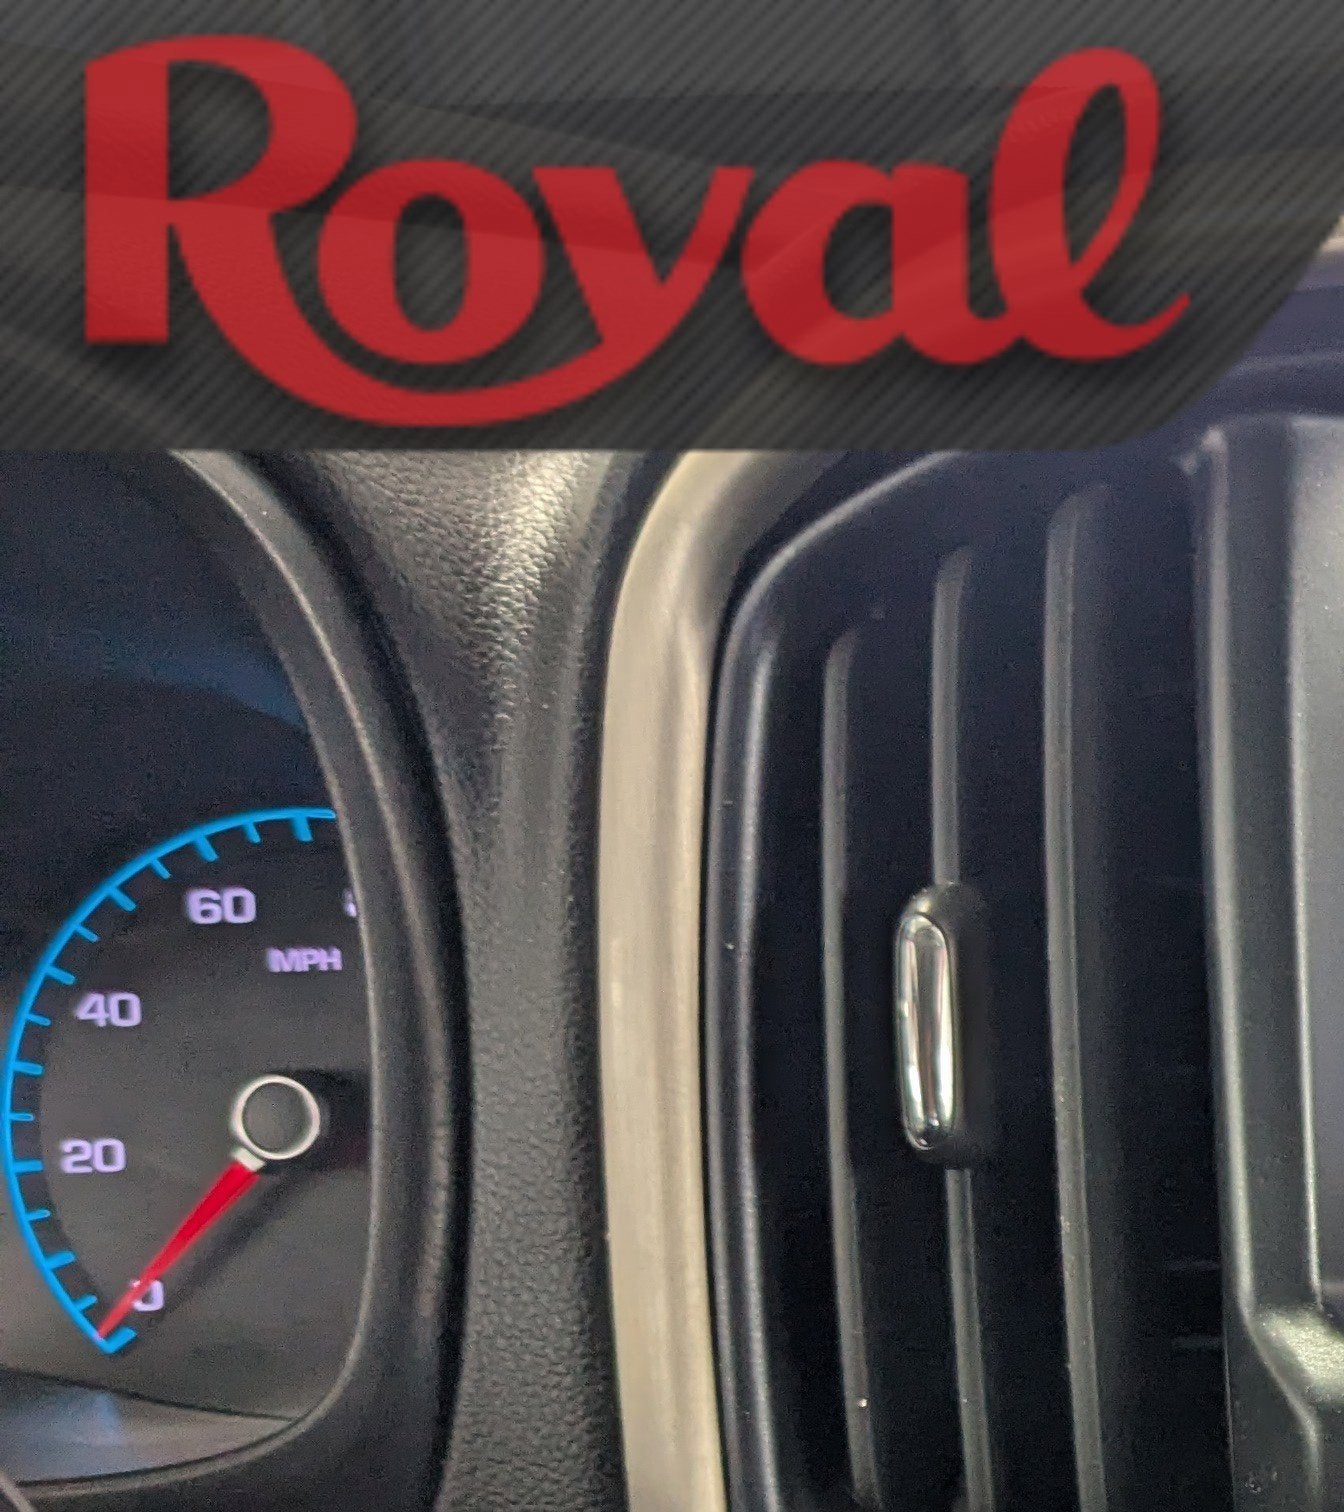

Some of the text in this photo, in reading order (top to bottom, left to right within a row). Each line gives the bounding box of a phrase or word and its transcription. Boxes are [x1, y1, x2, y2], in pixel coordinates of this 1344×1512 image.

[185, 886, 258, 926] 60
[267, 946, 343, 974] MPH
[74, 990, 142, 1029] 40
[58, 1137, 127, 1175] 20
